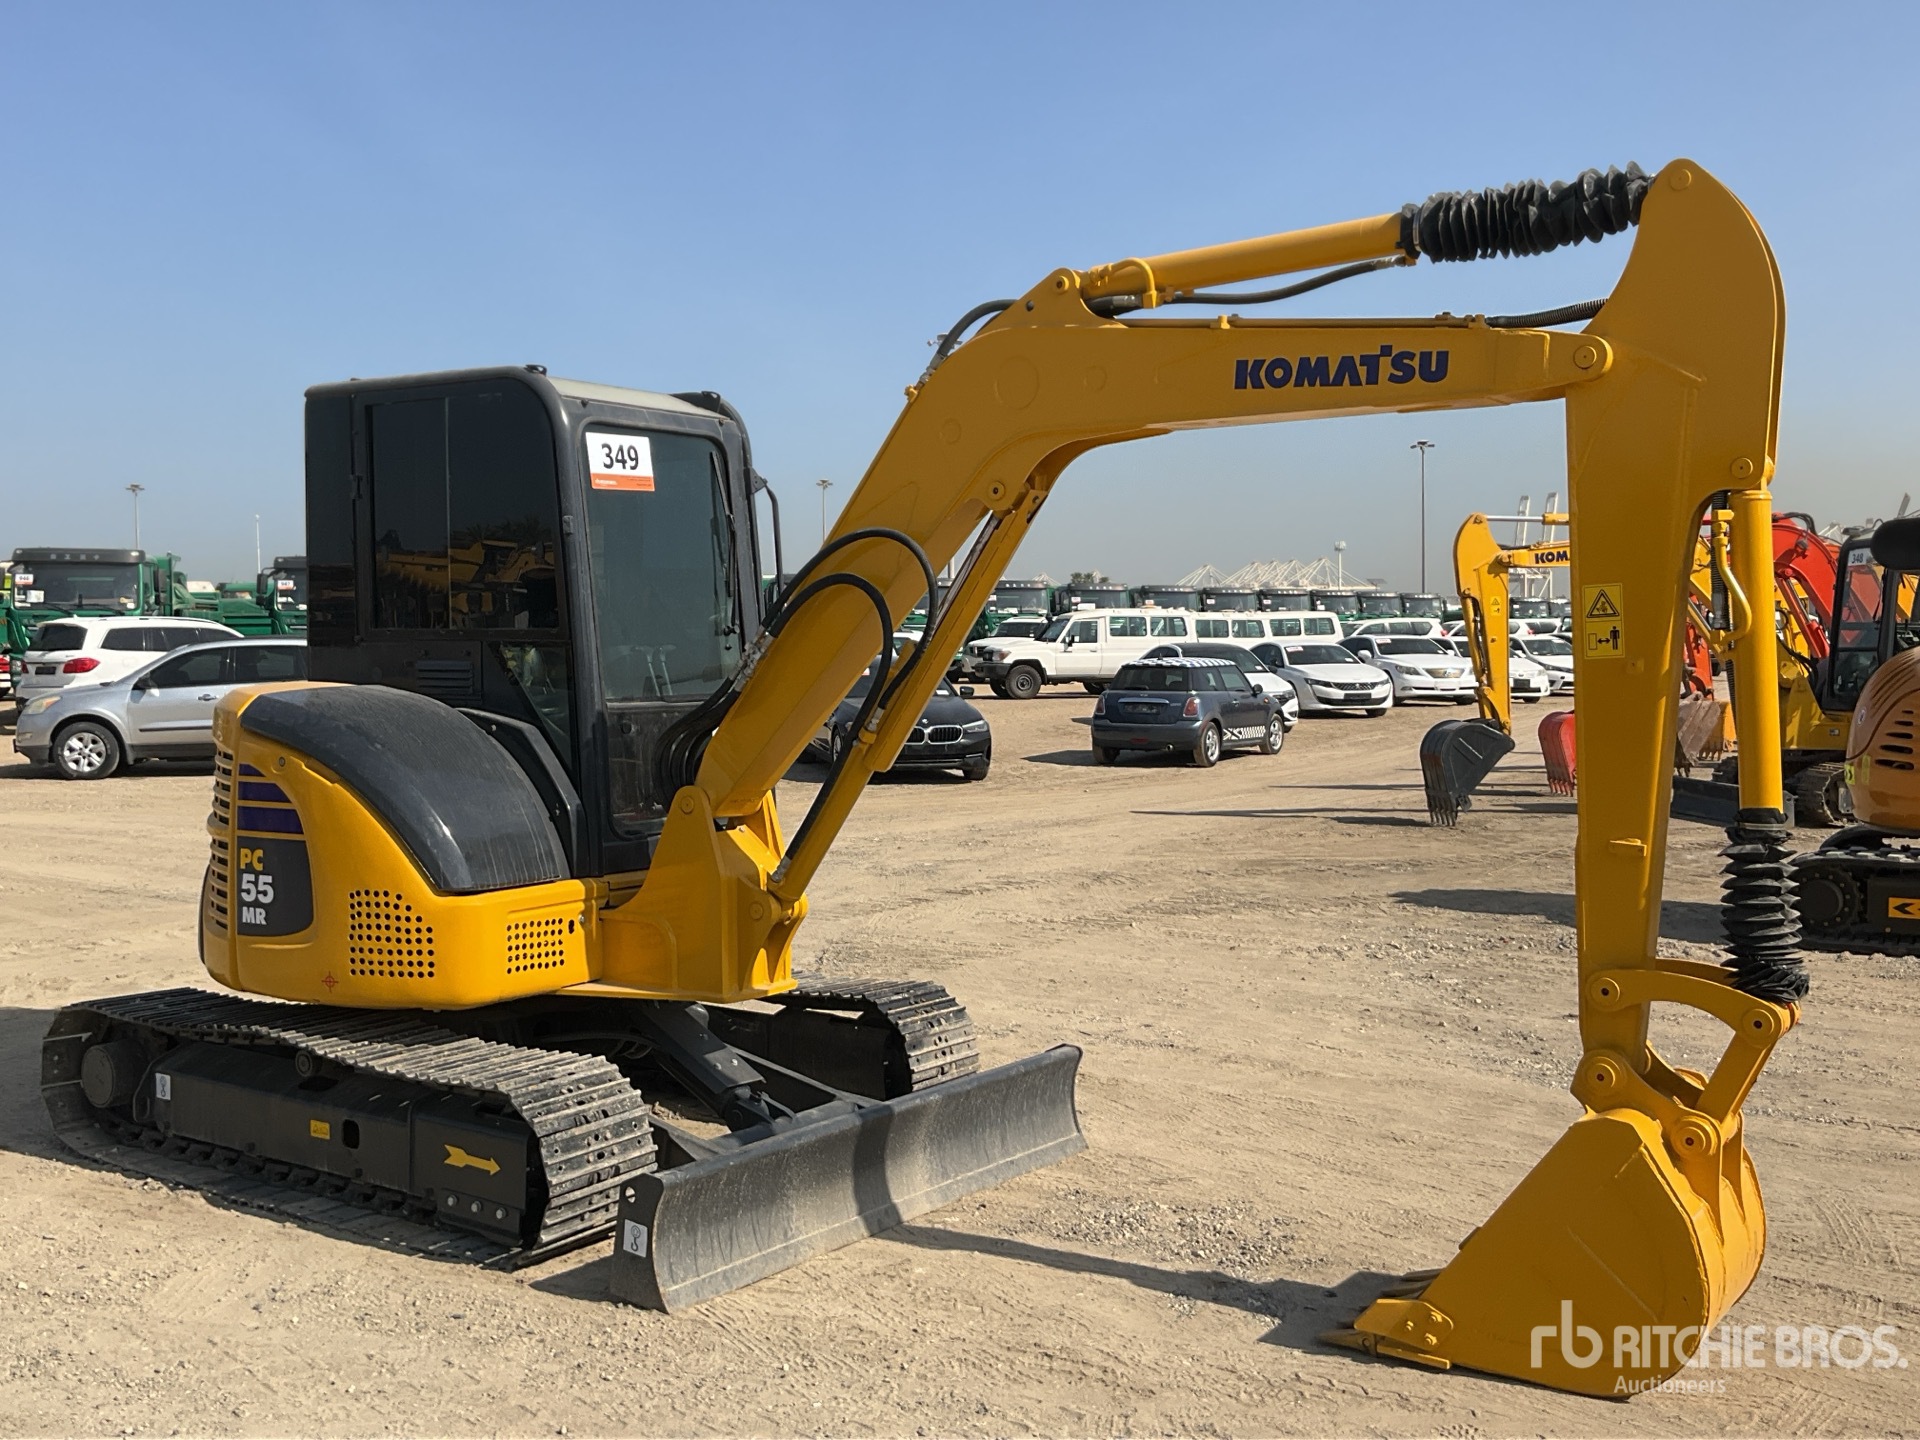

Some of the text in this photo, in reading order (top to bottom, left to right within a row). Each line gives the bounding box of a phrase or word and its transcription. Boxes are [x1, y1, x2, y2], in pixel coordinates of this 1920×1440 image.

[1234, 344, 1449, 390] KOMATSU
[601, 443, 639, 470] 349
[1534, 550, 1570, 564] KOM
[1851, 553, 1864, 563] 348
[240, 848, 264, 871] PC
[240, 873, 274, 904] 55
[242, 906, 267, 925] MR
